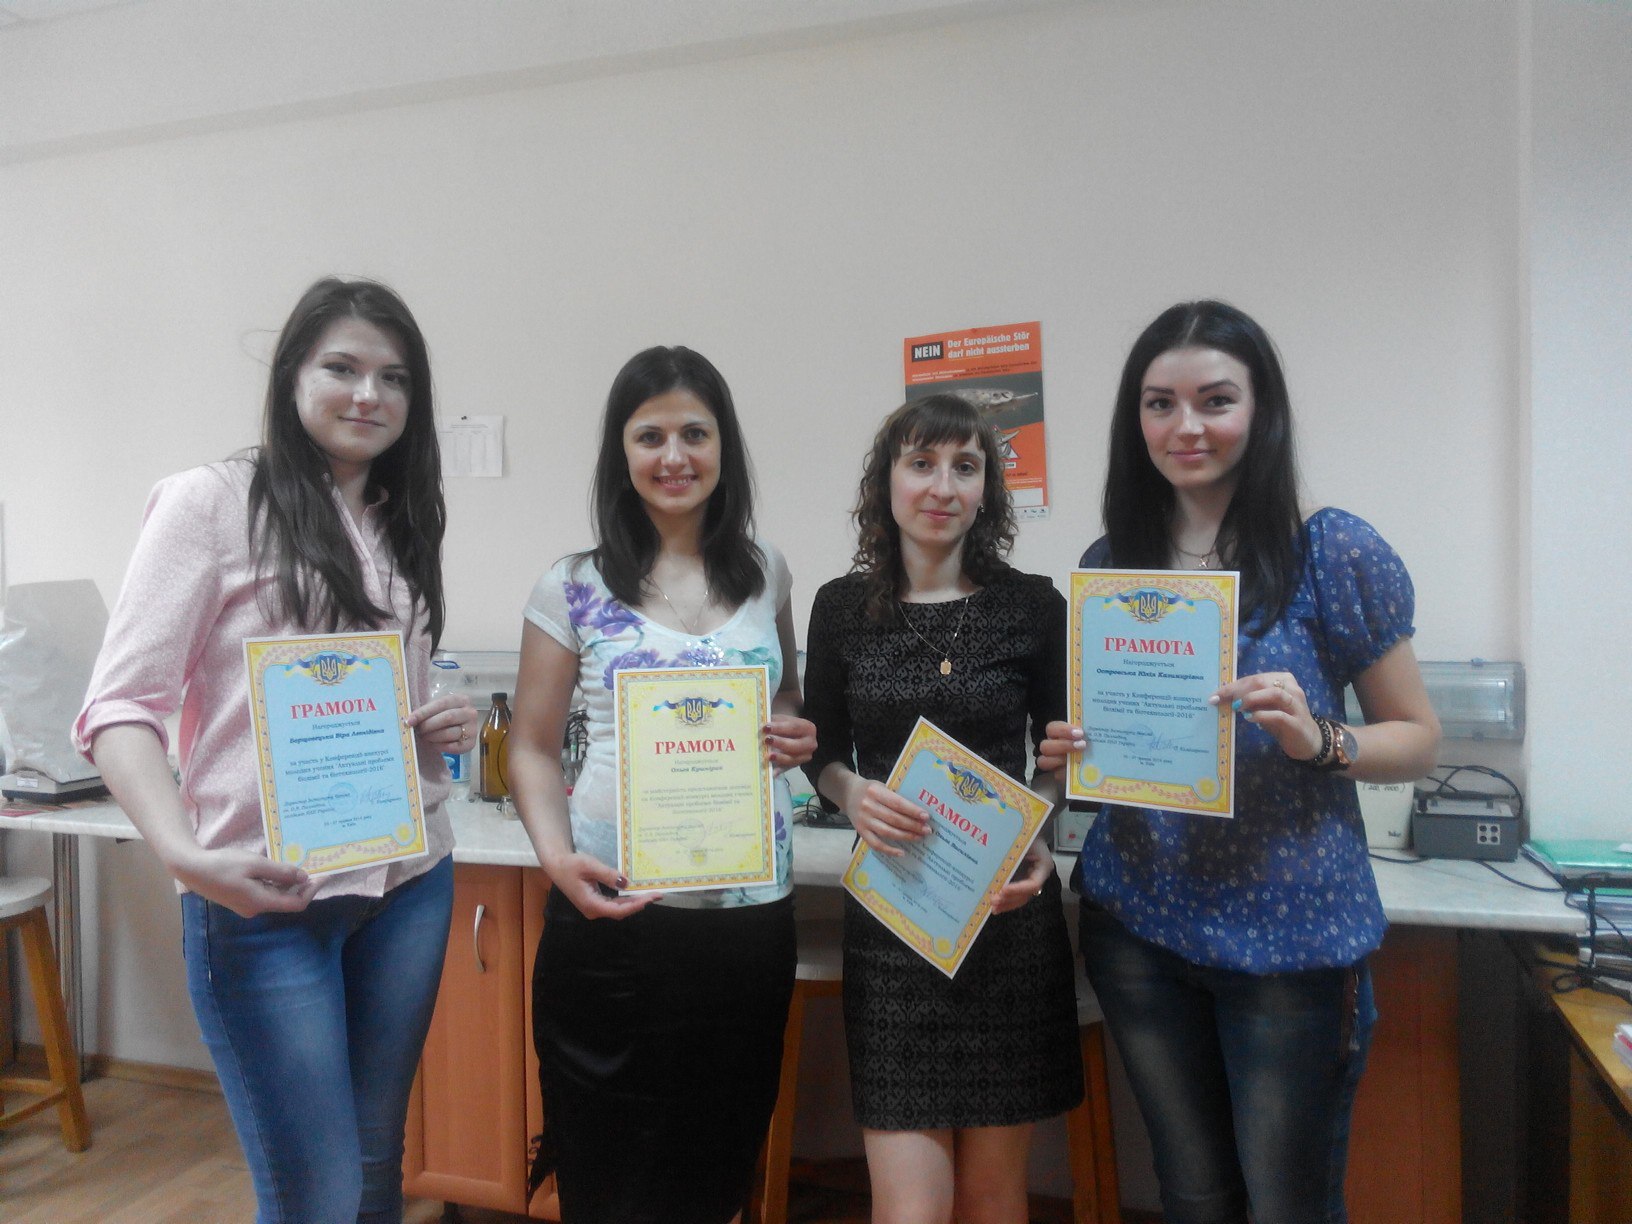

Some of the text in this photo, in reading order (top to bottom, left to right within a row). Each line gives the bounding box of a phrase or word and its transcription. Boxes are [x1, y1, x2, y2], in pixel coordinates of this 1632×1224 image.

[948, 331, 1030, 348] Der Europäische Stör
[914, 345, 941, 359] NEIN
[948, 343, 1030, 358] darf nicht aussterben
[1104, 637, 1195, 656] ГРАМОТА
[290, 698, 376, 719] ГРАМОТА
[655, 738, 736, 755] ГРАМОТА
[918, 788, 989, 847] ГРАМОТА
